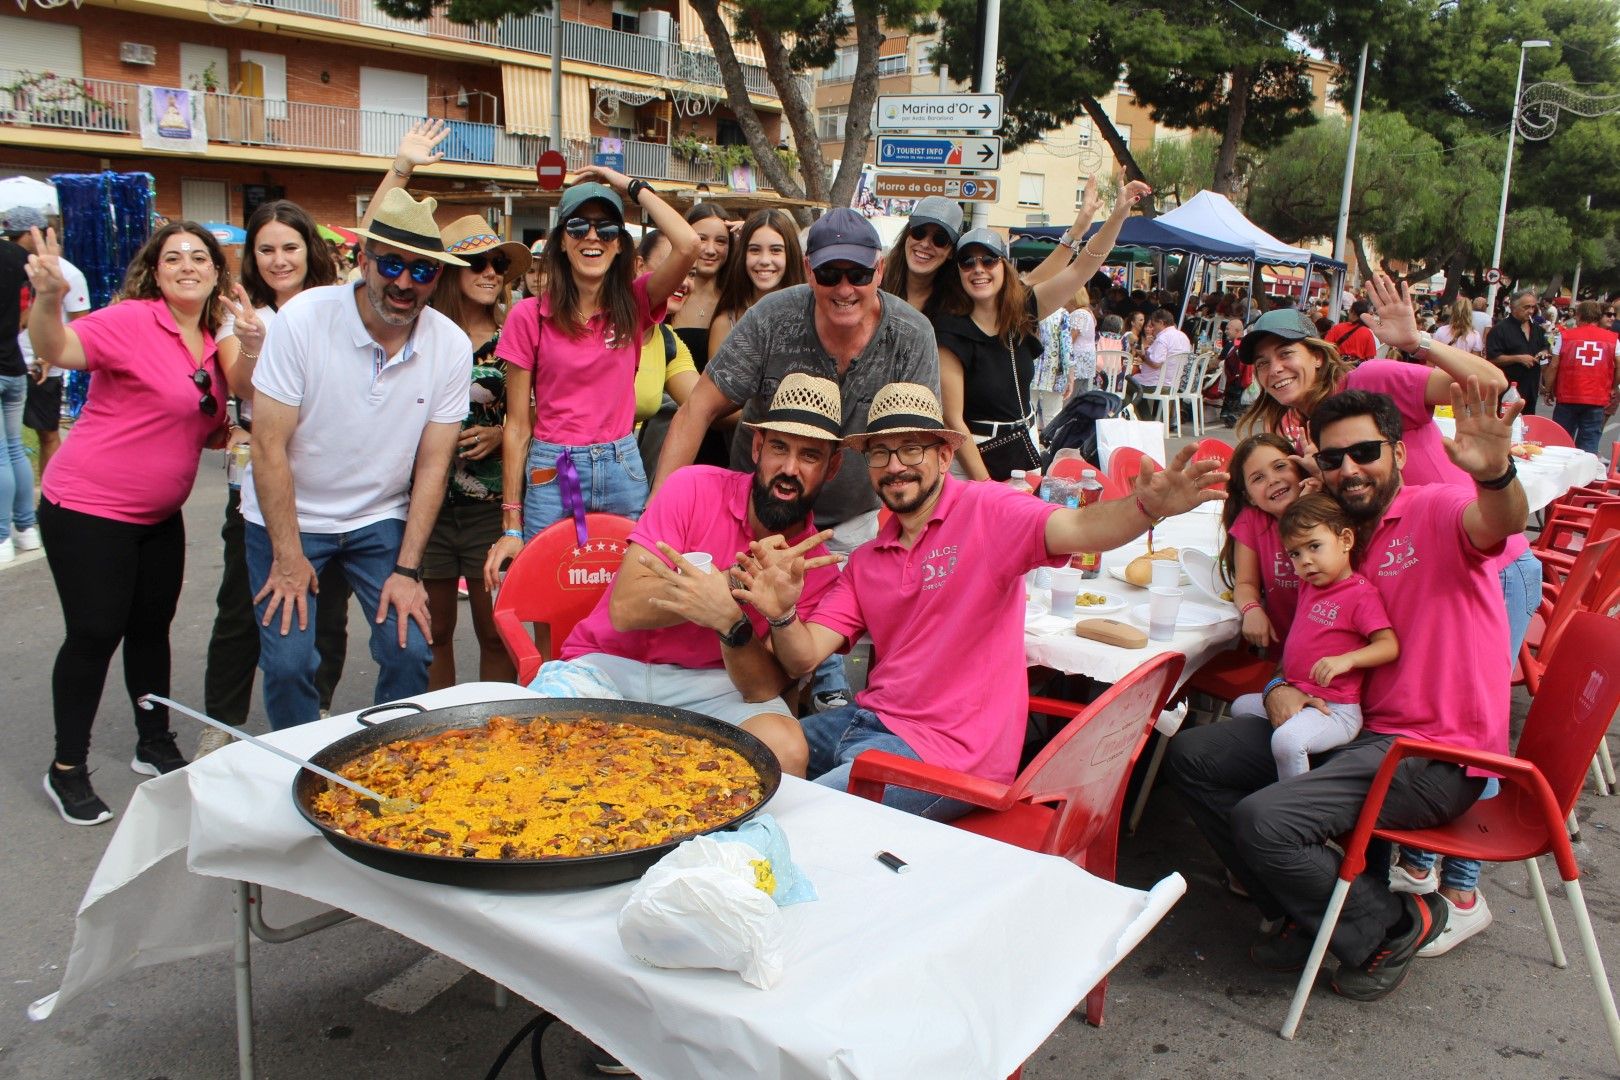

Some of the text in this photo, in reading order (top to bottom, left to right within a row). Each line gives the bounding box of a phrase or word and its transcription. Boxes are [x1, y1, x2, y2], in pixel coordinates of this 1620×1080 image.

[902, 103, 974, 114] Marina d'Or
[896, 147, 925, 155] TOURIST
[877, 181, 943, 193] Morro de Gos
[568, 567, 617, 585] Maho
